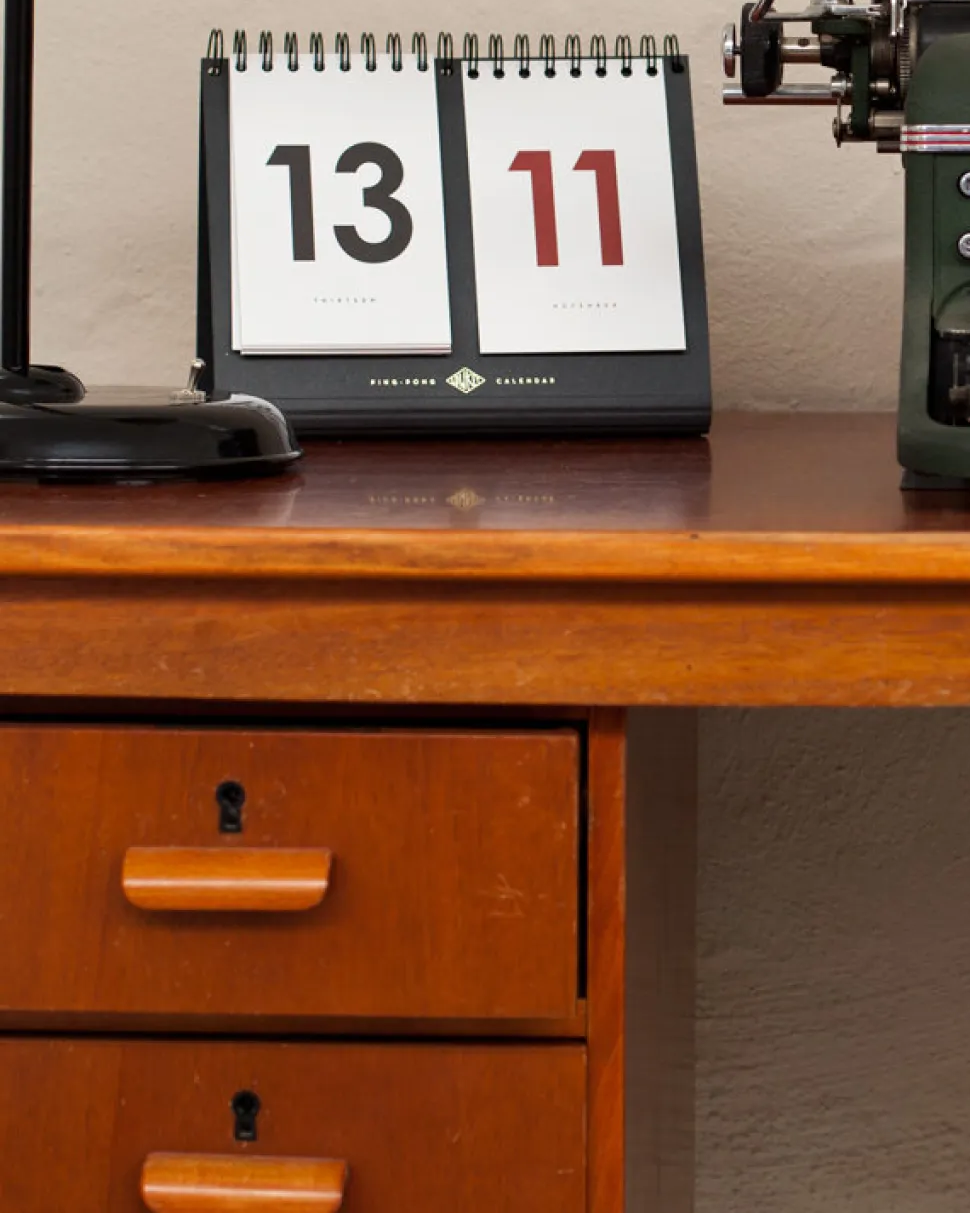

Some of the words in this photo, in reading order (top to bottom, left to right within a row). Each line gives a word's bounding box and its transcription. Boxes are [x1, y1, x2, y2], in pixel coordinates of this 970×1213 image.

[266, 141, 413, 264] 13
[508, 150, 623, 267] 11
[496, 376, 556, 385] CALENDAR
